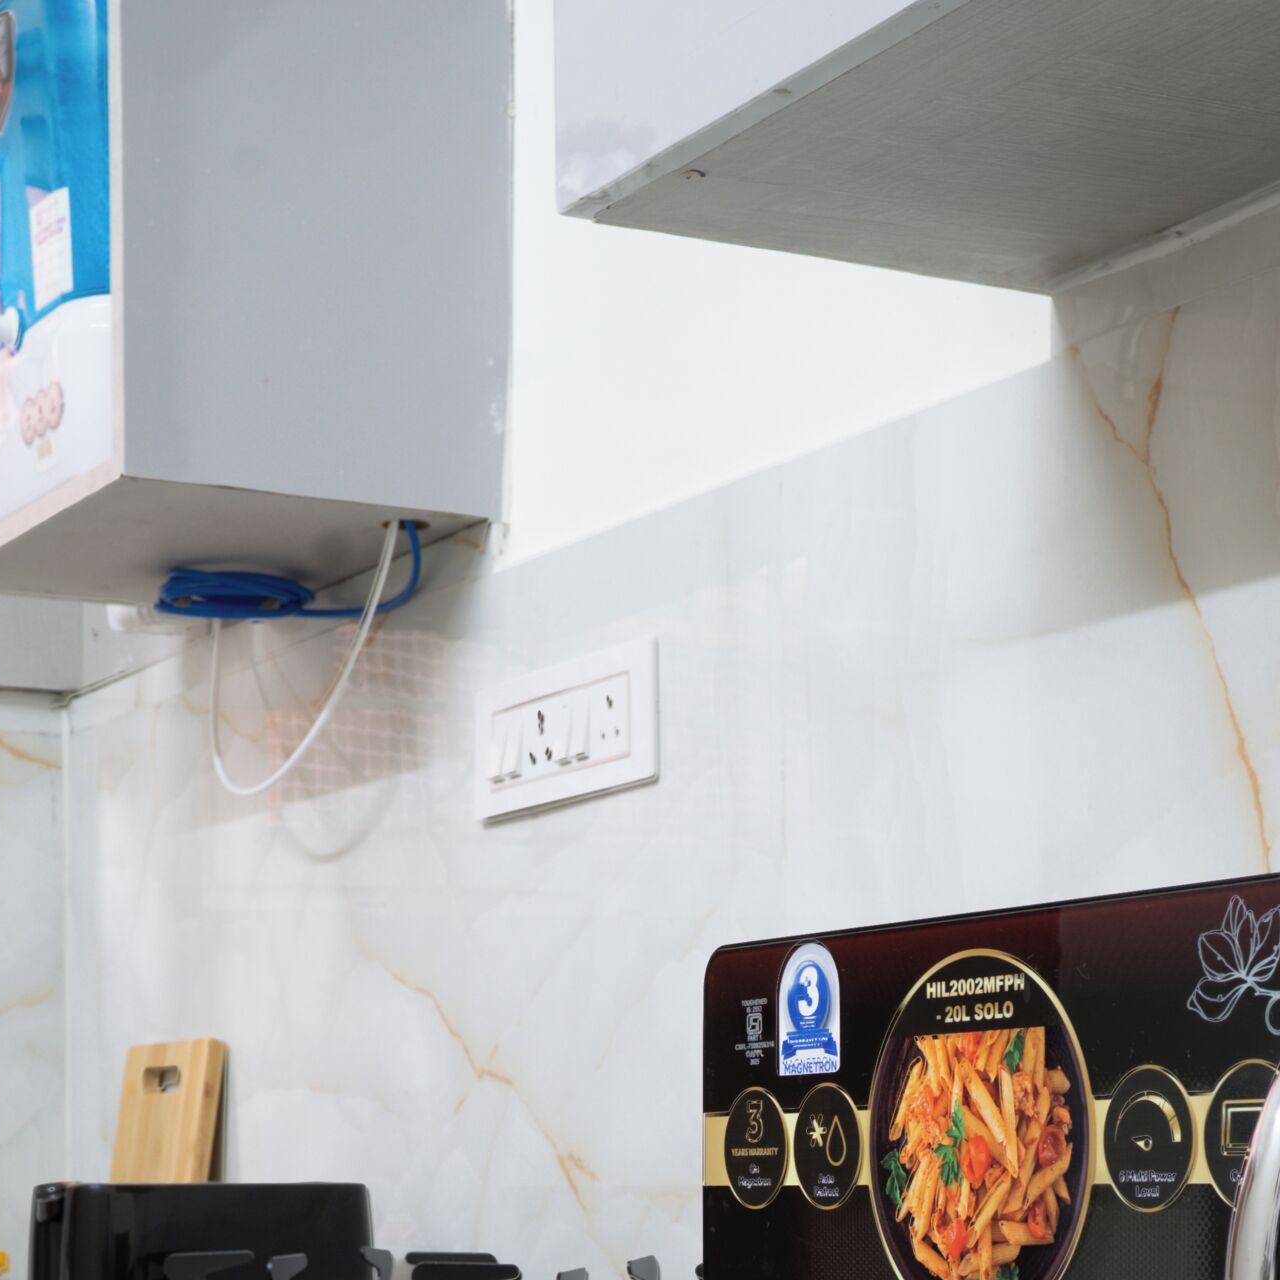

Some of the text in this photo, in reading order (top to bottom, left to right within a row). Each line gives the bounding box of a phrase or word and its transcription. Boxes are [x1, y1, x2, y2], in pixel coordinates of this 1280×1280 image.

[798, 965, 819, 1017] 3
[926, 972, 1025, 999] HIL2002MFPH
[944, 1004, 971, 1023] 20L
[974, 1000, 1014, 1021] SOLO
[784, 1060, 838, 1075] MAGNETRON
[745, 1100, 764, 1143] 3
[1149, 1169, 1177, 1182] Power
[1135, 1185, 1160, 1197] Level
